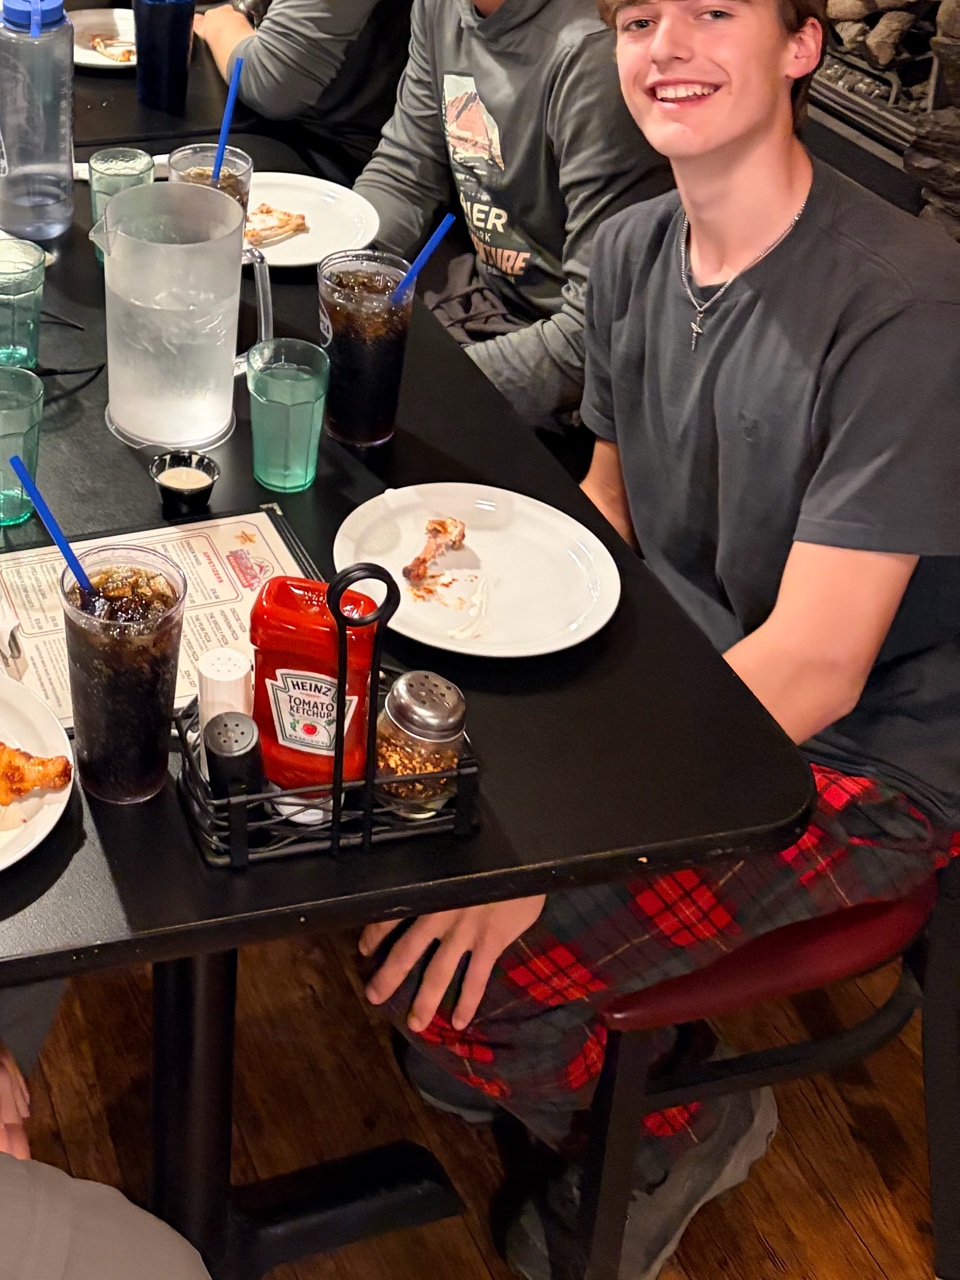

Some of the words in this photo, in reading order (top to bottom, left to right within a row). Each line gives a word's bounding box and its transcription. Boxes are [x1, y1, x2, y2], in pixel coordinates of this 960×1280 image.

[202, 551, 223, 583] APPETIZERS
[291, 680, 332, 697] HEINZ
[288, 694, 335, 712] TOMATO
[290, 705, 332, 719] KETCHUP
